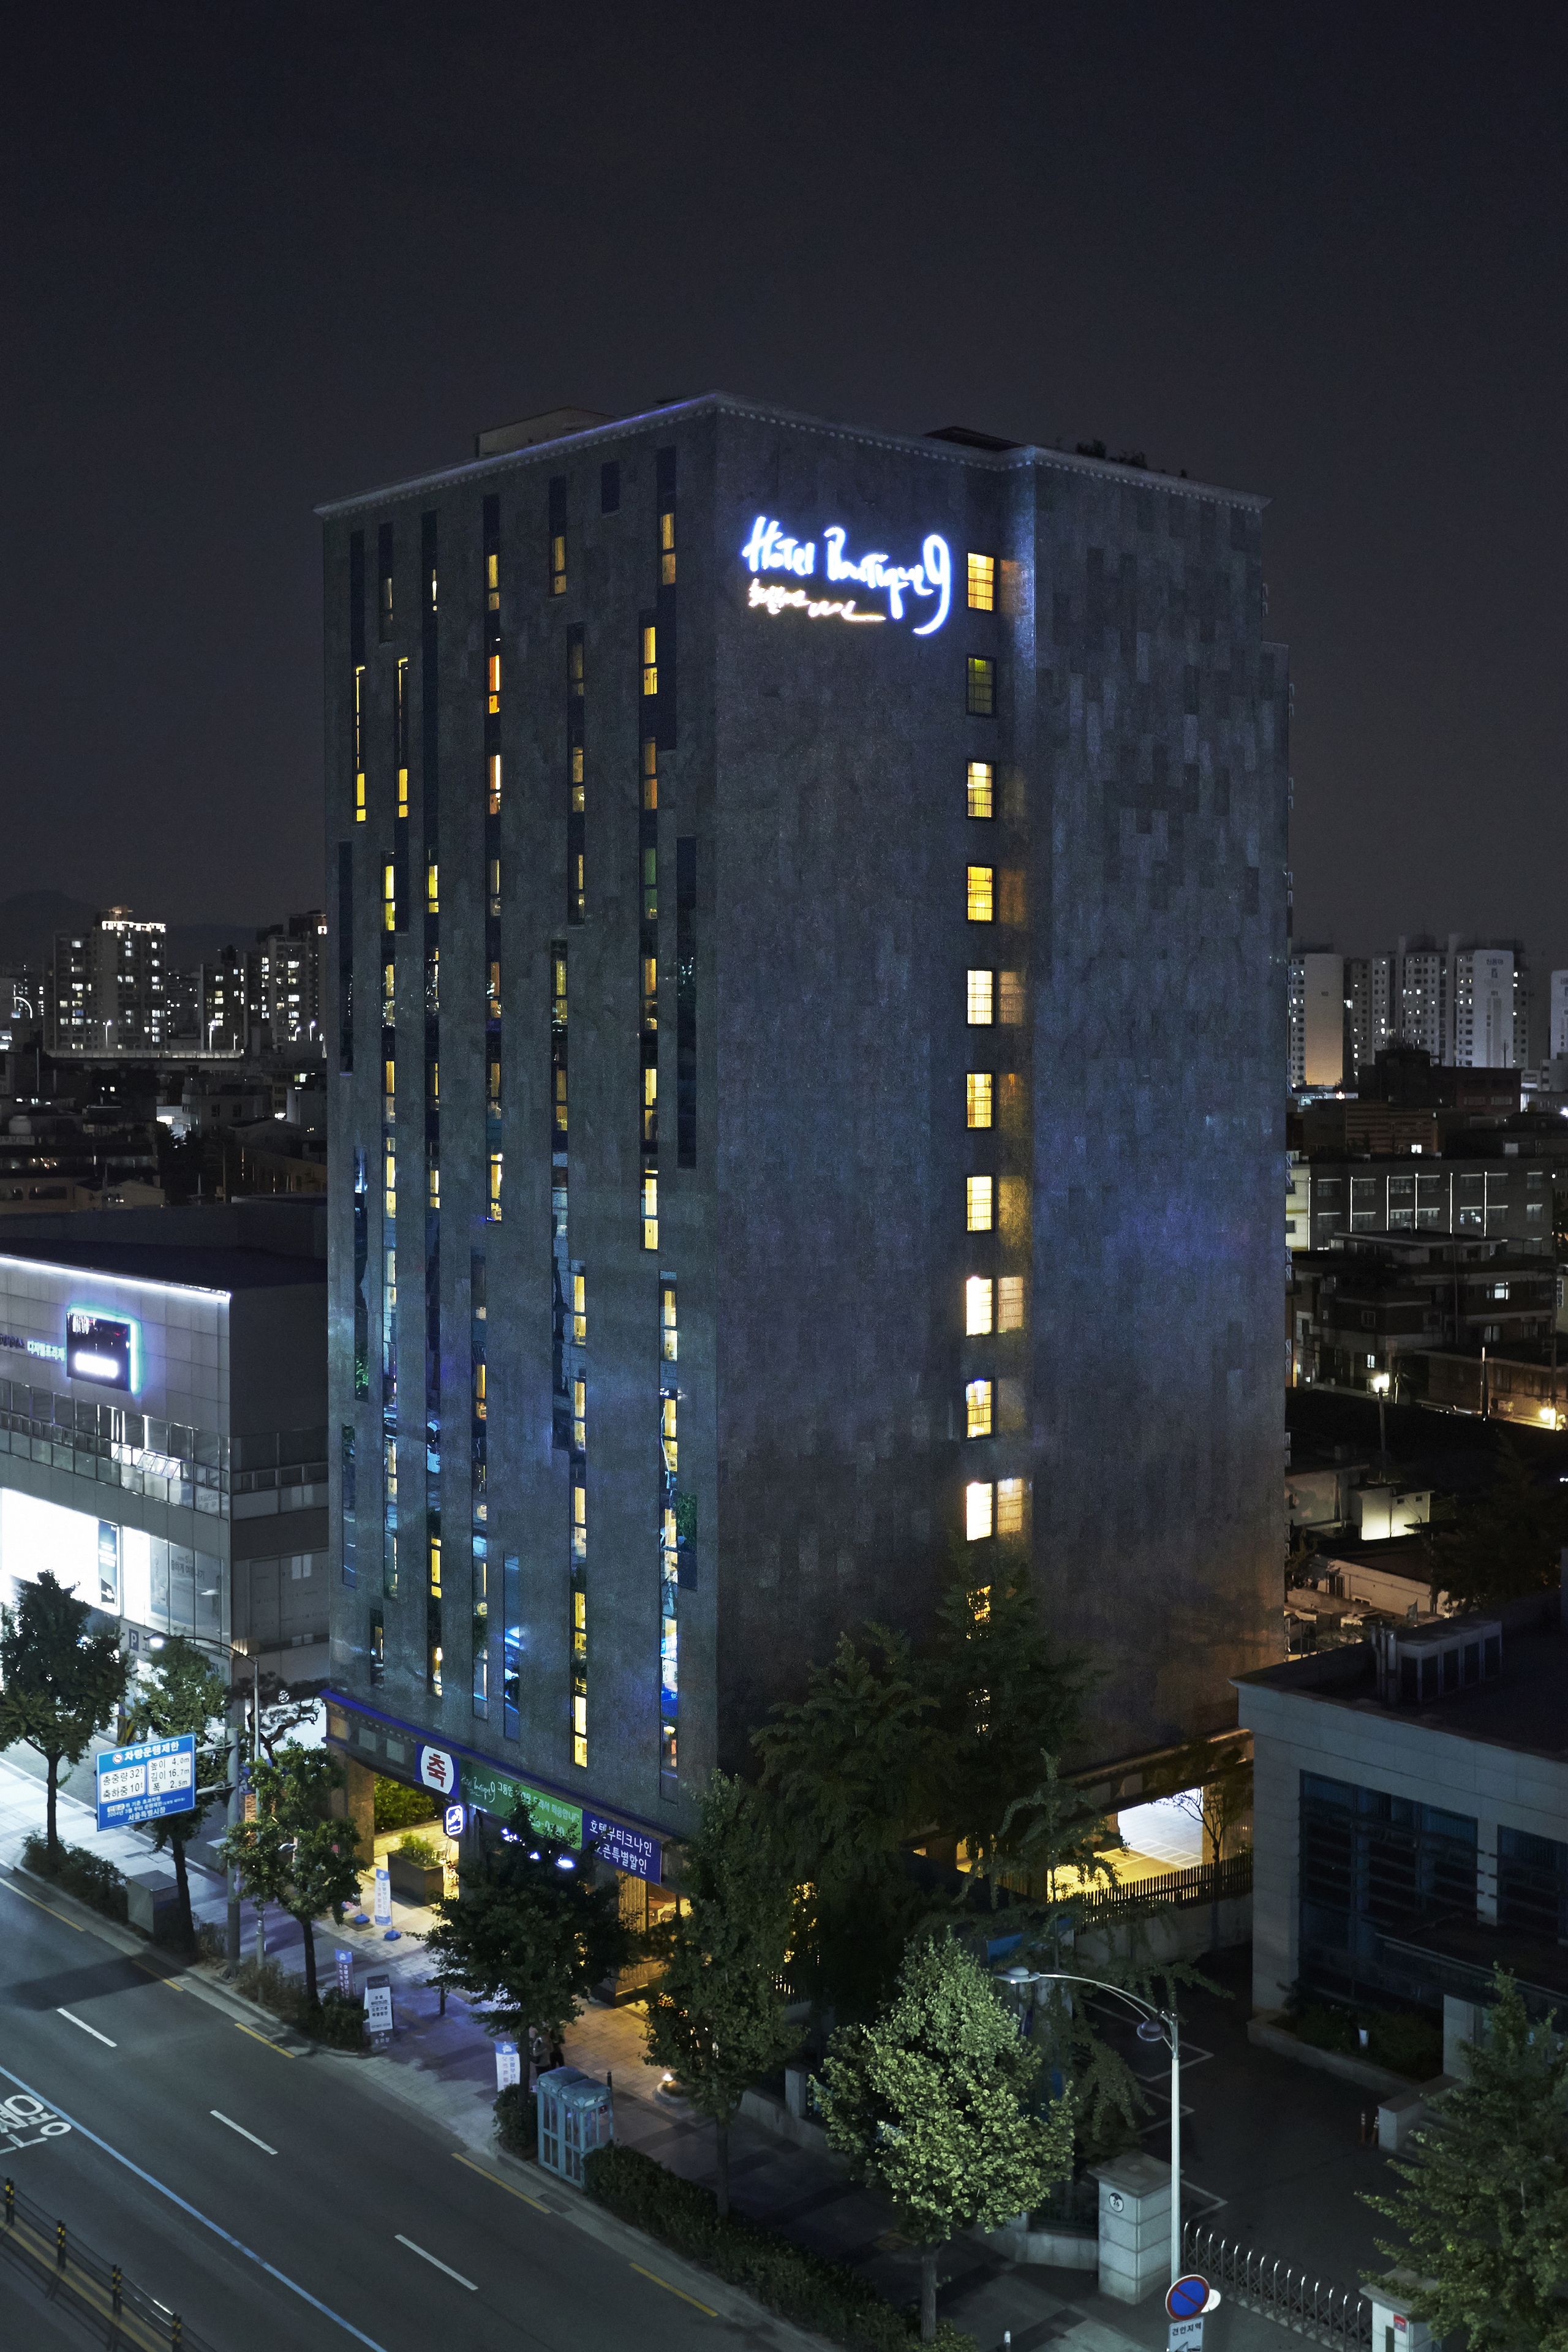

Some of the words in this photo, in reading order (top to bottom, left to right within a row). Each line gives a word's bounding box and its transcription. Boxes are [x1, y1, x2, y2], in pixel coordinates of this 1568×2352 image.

[131, 1632, 137, 1647] P
[124, 1741, 179, 1761] 차량운행제한
[151, 1758, 165, 1771] 높이
[426, 1753, 447, 1788] 축
[104, 1771, 128, 1785] 총중량
[151, 1770, 165, 1782] 길이
[104, 1785, 128, 1799] 축하중
[153, 1782, 160, 1792] 폭
[497, 1781, 514, 1797] 그동안
[589, 1820, 652, 1858] 호텔부티크나인
